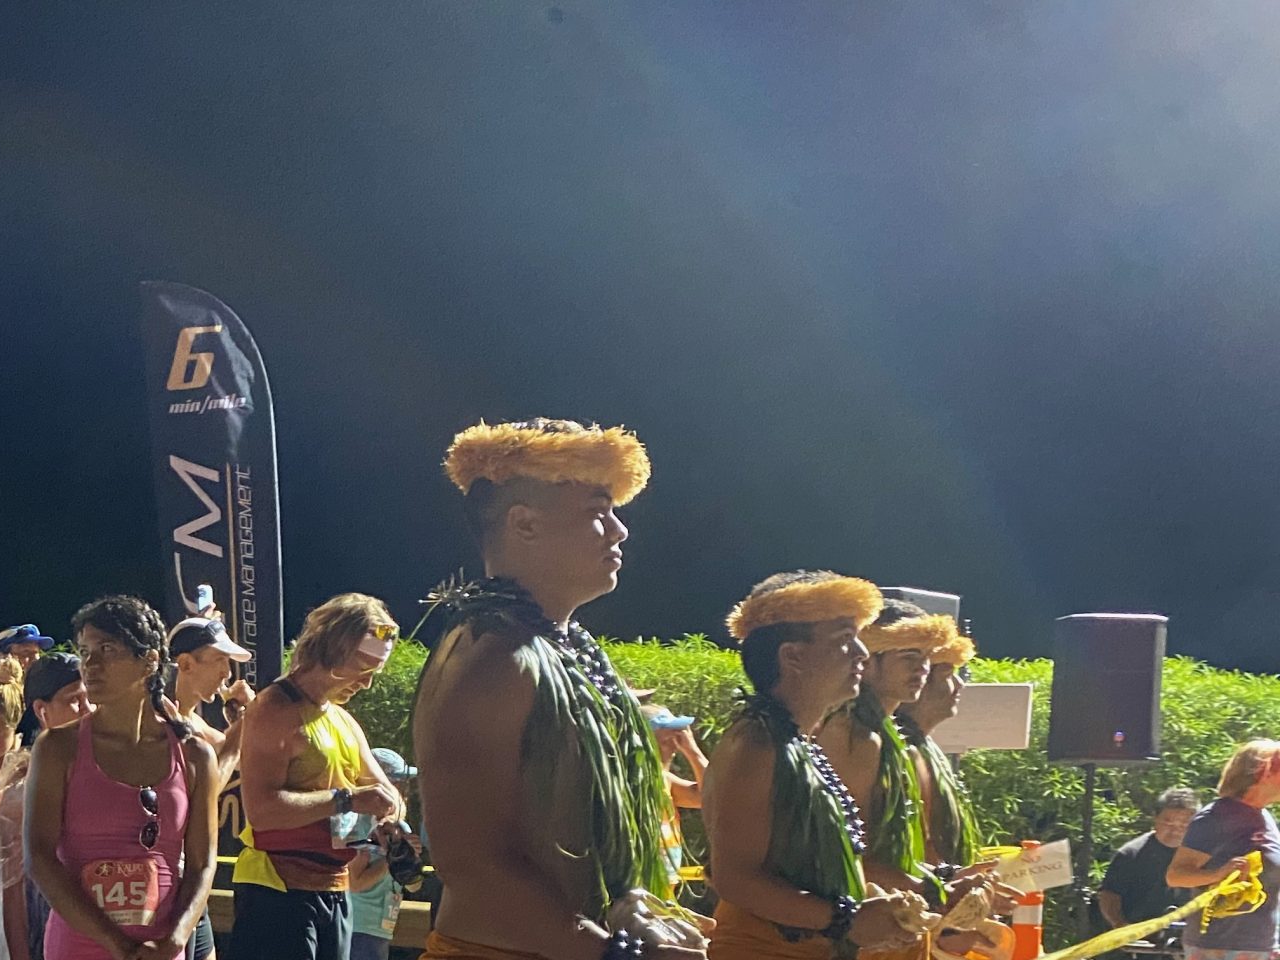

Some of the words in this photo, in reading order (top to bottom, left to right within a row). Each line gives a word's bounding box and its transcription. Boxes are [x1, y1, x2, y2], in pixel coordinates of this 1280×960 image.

[166, 324, 223, 391] 6
[168, 393, 247, 414] min/mile
[91, 881, 147, 908] 145
